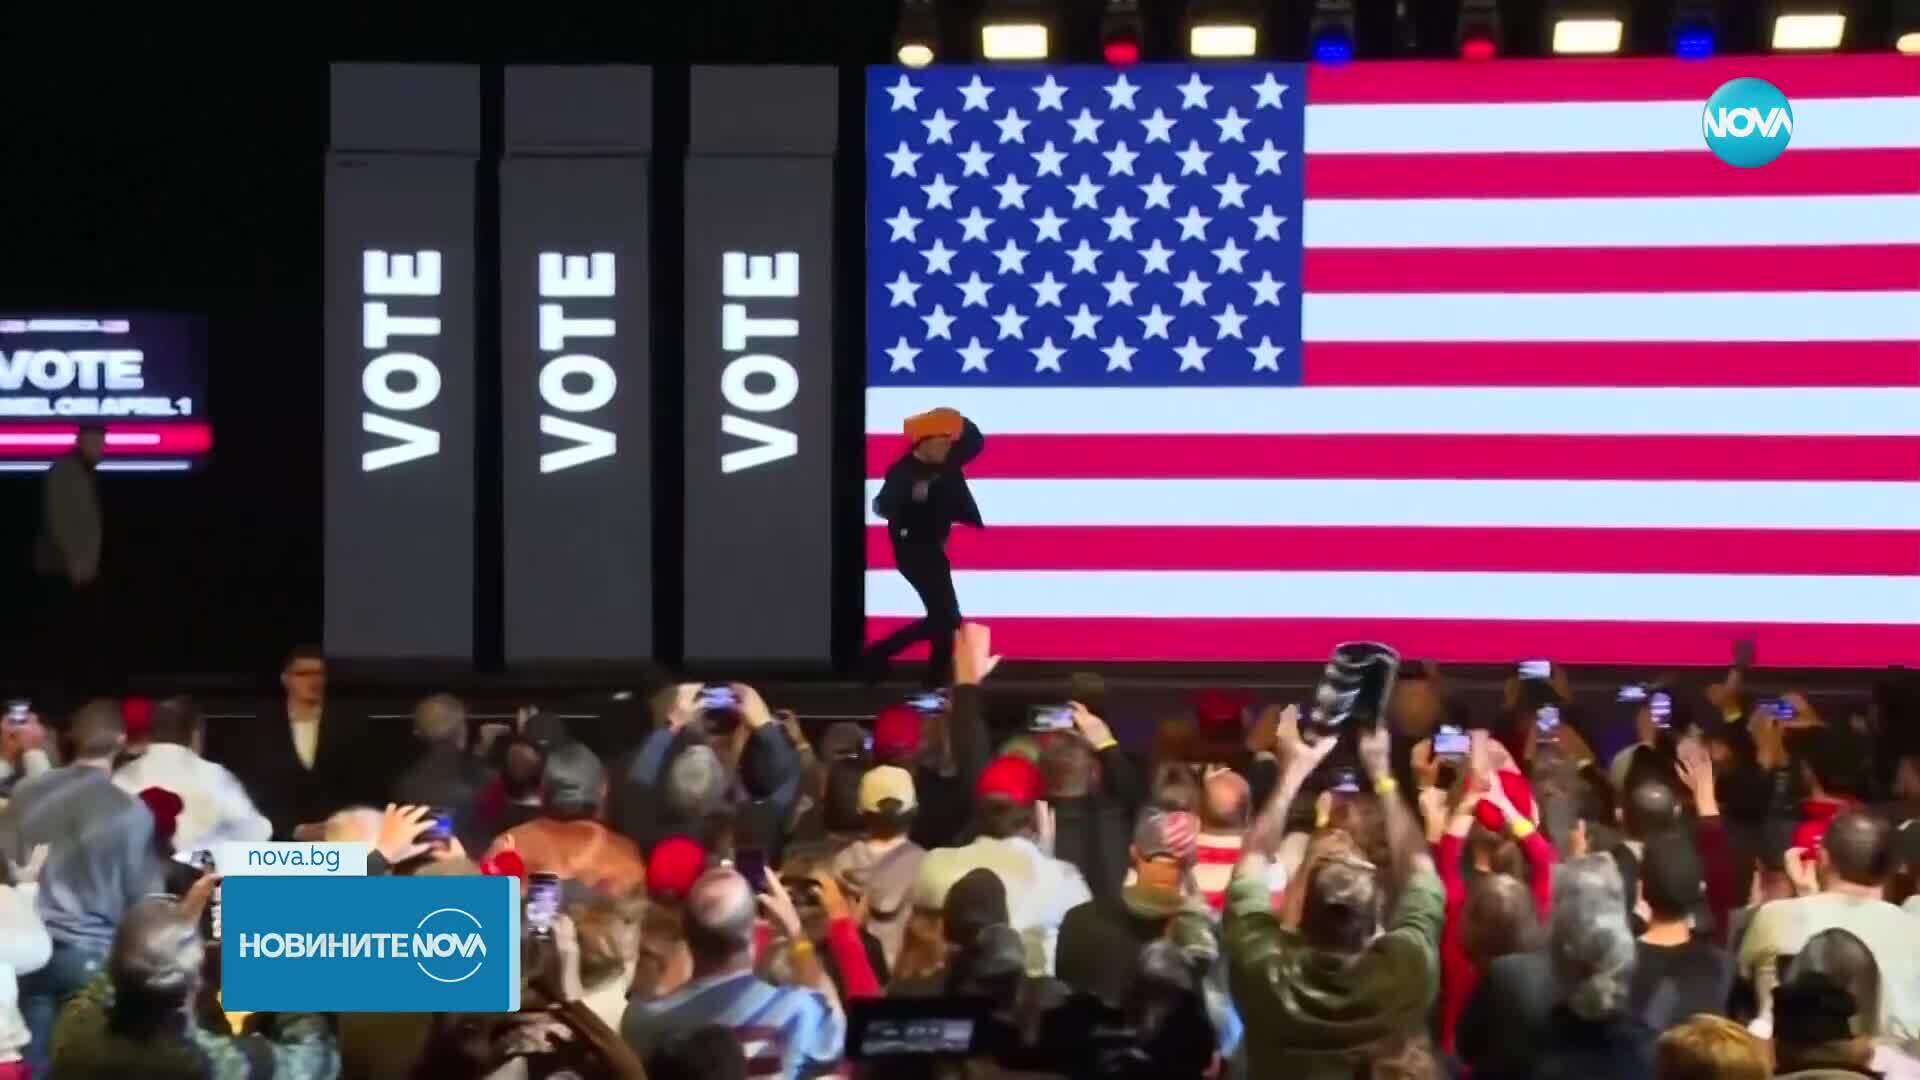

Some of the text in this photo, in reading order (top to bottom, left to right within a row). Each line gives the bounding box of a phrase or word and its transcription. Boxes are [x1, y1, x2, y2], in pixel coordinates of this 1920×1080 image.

[0, 350, 144, 390] VOTE
[362, 250, 441, 472] VOTE
[539, 252, 617, 474] VOTE
[721, 252, 799, 474] VOTE
